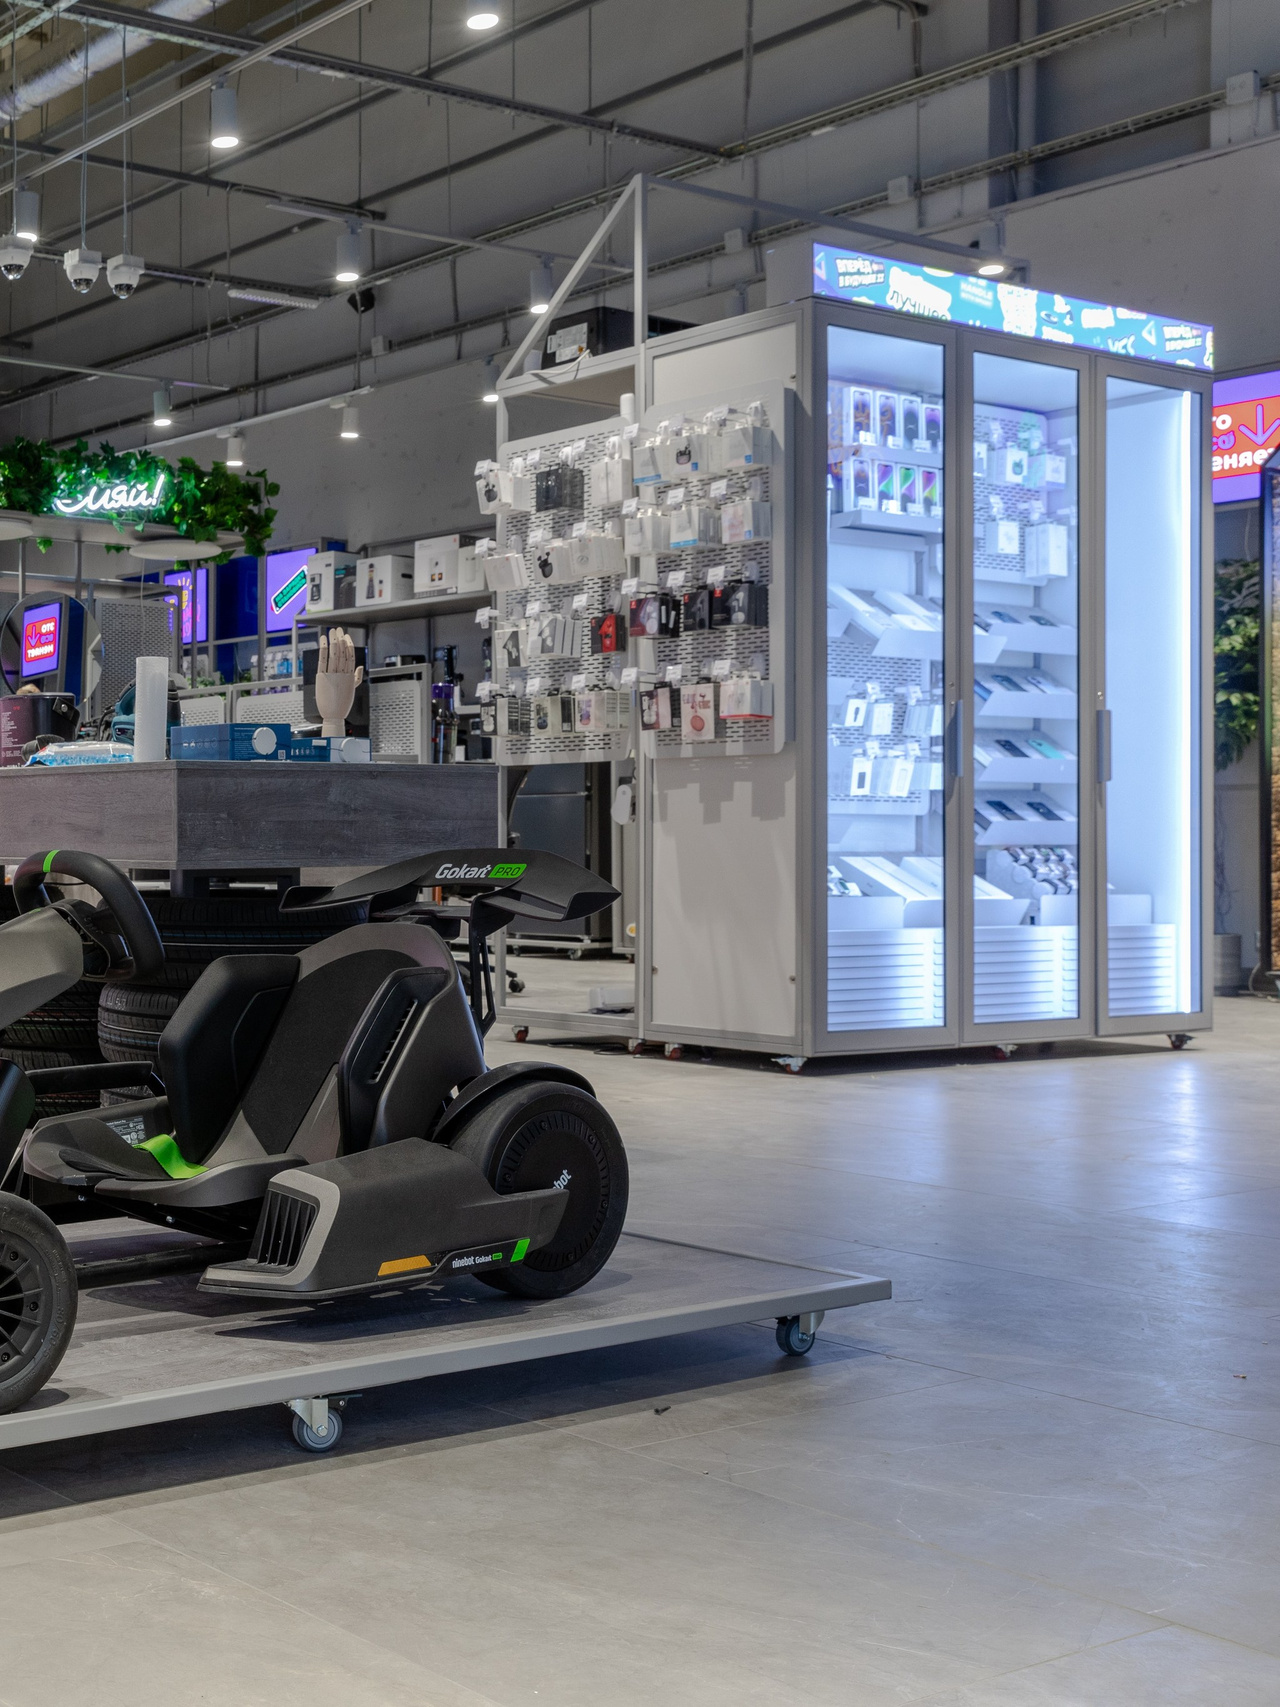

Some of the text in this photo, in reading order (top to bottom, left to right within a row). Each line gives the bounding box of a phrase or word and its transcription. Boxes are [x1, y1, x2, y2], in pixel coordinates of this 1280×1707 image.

[435, 863, 520, 879] Gokart PRO
[452, 1256, 475, 1268] ninebot
